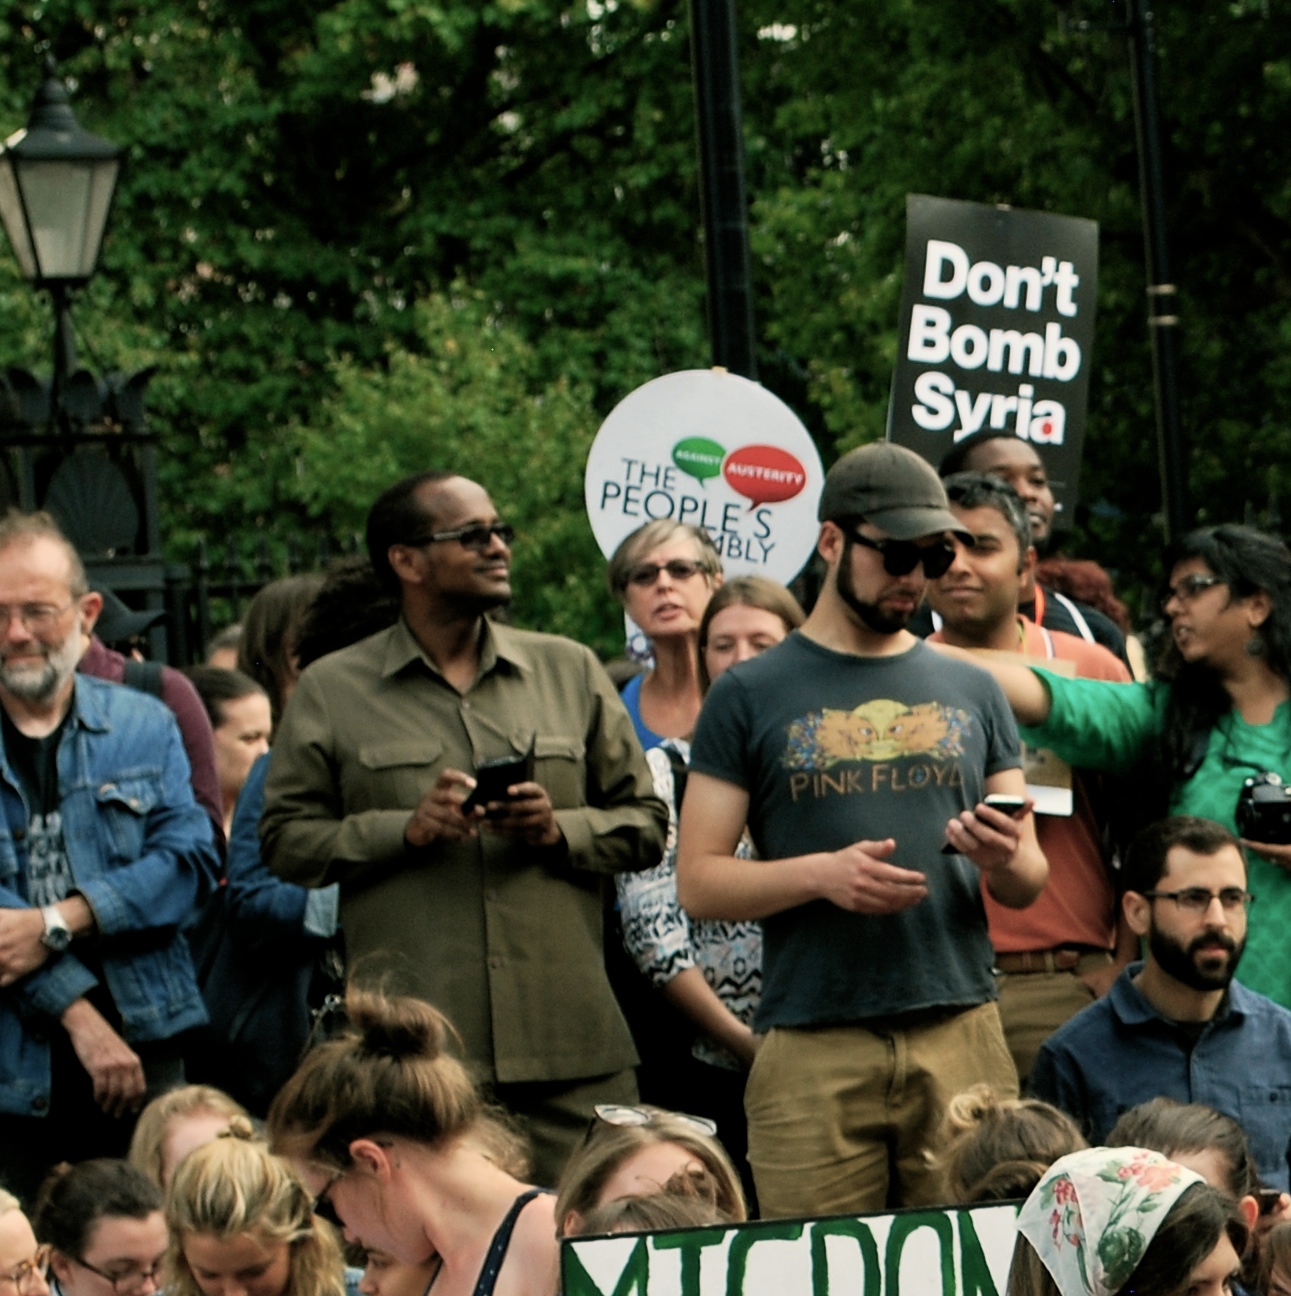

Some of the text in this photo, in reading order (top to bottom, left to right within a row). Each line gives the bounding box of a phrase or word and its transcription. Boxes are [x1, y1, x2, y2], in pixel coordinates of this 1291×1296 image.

[923, 239, 1080, 317] Don't
[907, 303, 1081, 382] Bomb
[911, 371, 1066, 445] Syria
[621, 457, 677, 491] THE
[675, 450, 721, 466] AGAINST
[727, 462, 804, 485] AUSTERITY
[789, 769, 864, 801] PINK
